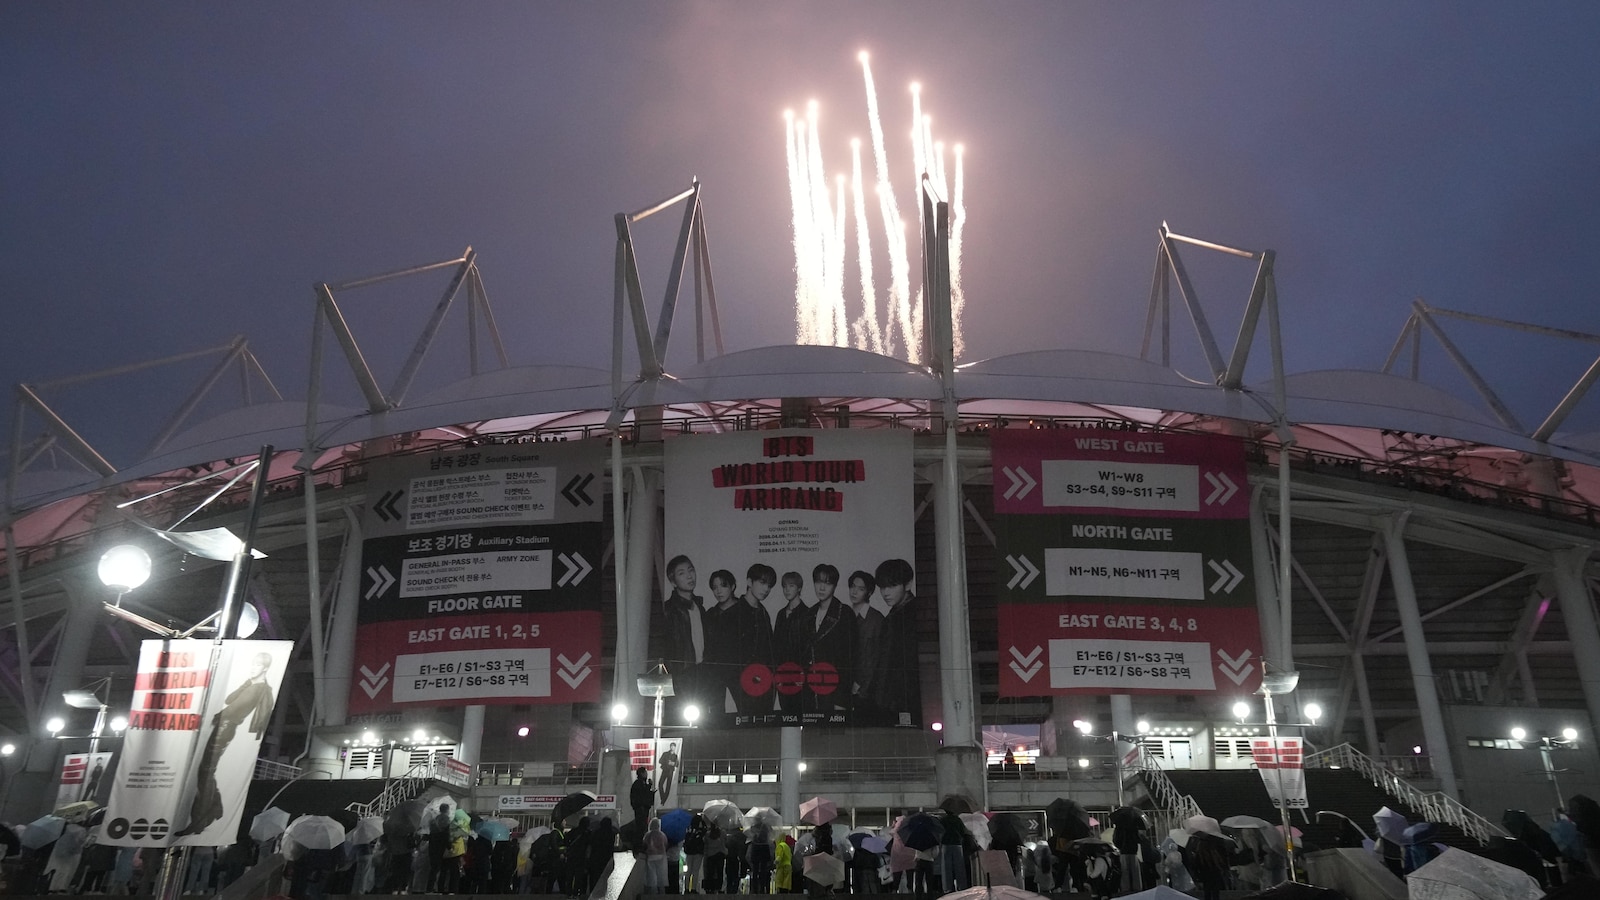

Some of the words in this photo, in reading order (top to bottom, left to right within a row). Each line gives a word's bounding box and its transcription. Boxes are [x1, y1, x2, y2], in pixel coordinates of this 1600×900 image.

[769, 436, 807, 457] BTS
[1074, 438, 1119, 451] WEST
[1124, 441, 1165, 454] GATE
[431, 456, 453, 470] 남측
[458, 452, 481, 467] 광장
[512, 454, 539, 462] Square
[721, 461, 793, 485] WORLD
[802, 460, 856, 483] TOUR
[1098, 471, 1143, 483] W1~W8
[742, 487, 835, 511] ARIRANG
[1111, 486, 1152, 497] S9~S11
[1156, 487, 1176, 499] 구역
[478, 537, 513, 546] Auxiliary
[515, 536, 549, 544] Stadium
[1072, 525, 1127, 538] NORTH
[1131, 527, 1173, 541] GATE
[407, 538, 432, 552] 보조
[435, 533, 473, 550] 경기장
[409, 561, 441, 570] GENERAL
[442, 558, 471, 566] IN-PASS
[1114, 568, 1156, 578] N6~N11
[1160, 569, 1180, 580] 구역
[428, 597, 478, 613] FLOOR
[482, 595, 522, 609] GATE
[1059, 615, 1099, 628] EAST
[1104, 616, 1146, 629] GATE
[1150, 617, 1165, 632] 3,
[1169, 618, 1183, 633] 4,
[1187, 618, 1197, 631] 8
[408, 628, 445, 643] EAST
[449, 625, 491, 640] GATE
[495, 625, 508, 640] 1,
[512, 624, 527, 640] 2,
[531, 624, 540, 637] 5
[160, 652, 189, 668] BTS
[1076, 651, 1113, 661] E1~E6
[1124, 652, 1161, 663] S1~S3
[1164, 653, 1184, 664] 구역
[420, 663, 454, 675] E1~E6
[465, 661, 501, 672] S1~S3
[504, 659, 524, 672] 구역
[1073, 665, 1117, 676] E7~E12
[1127, 667, 1167, 677] S6~S8
[1170, 667, 1190, 679] 구역
[149, 672, 198, 688] WORLD
[414, 677, 455, 690] E7~E12
[467, 676, 504, 687] S6~S8
[508, 674, 529, 686] 구역
[151, 693, 188, 709] TOUR
[131, 714, 198, 730] ARIRANG
